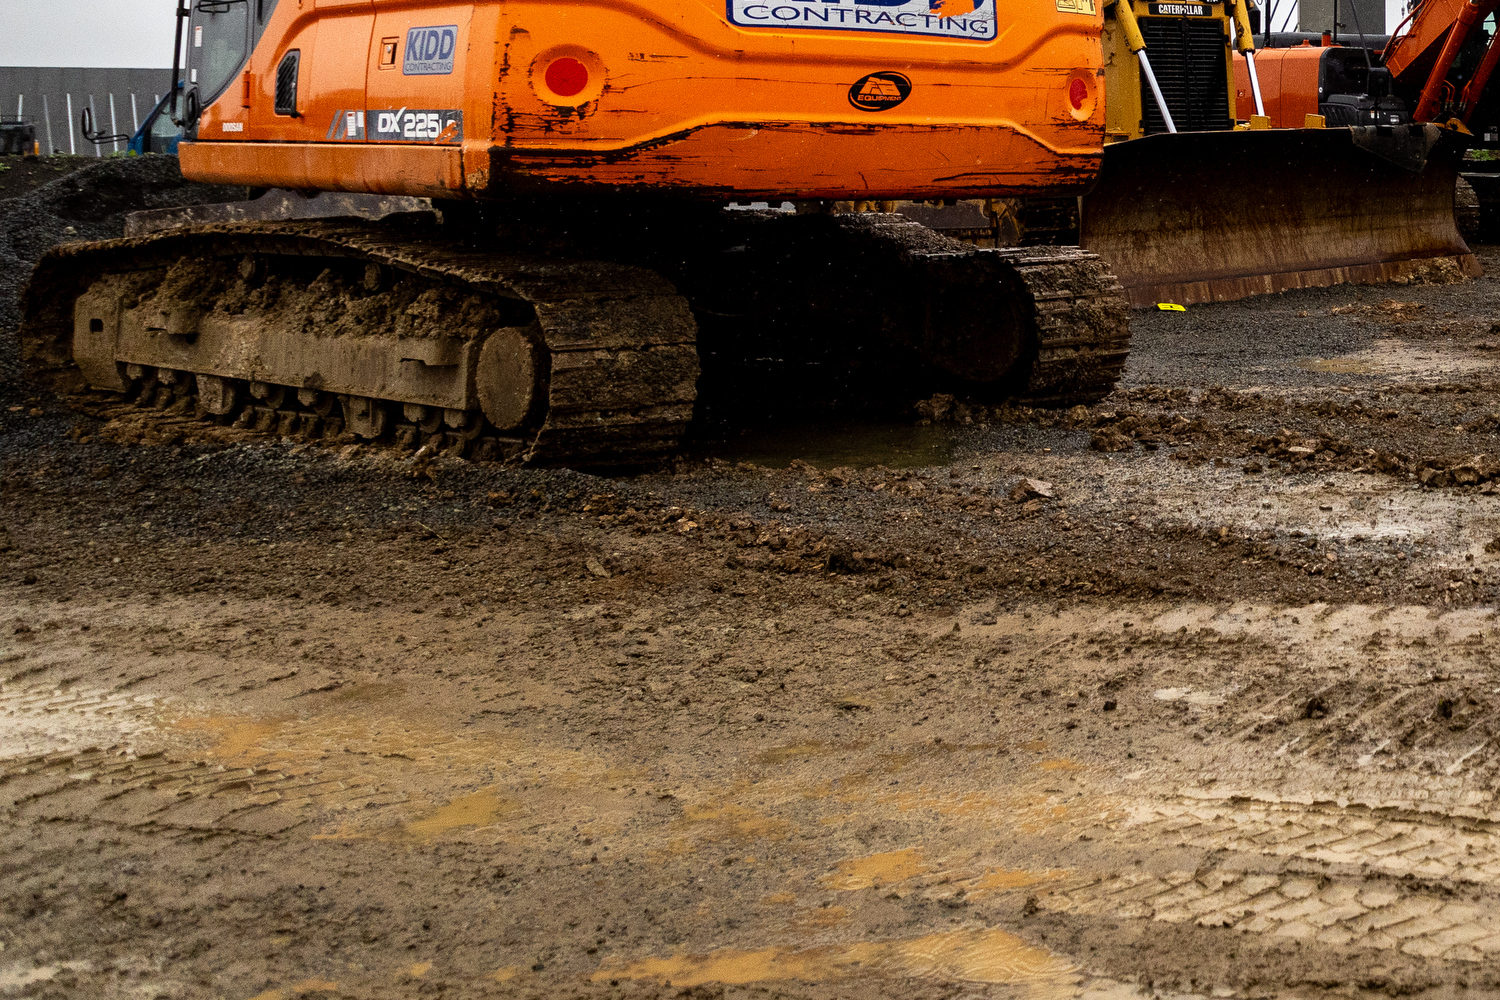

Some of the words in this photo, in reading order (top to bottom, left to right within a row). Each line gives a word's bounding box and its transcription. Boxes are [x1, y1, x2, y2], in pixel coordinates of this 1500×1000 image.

[743, 4, 989, 34] CONTRACTING
[406, 29, 454, 61] KIDD
[405, 62, 452, 71] CONTRACTING
[858, 94, 902, 102] EQUIPMENT
